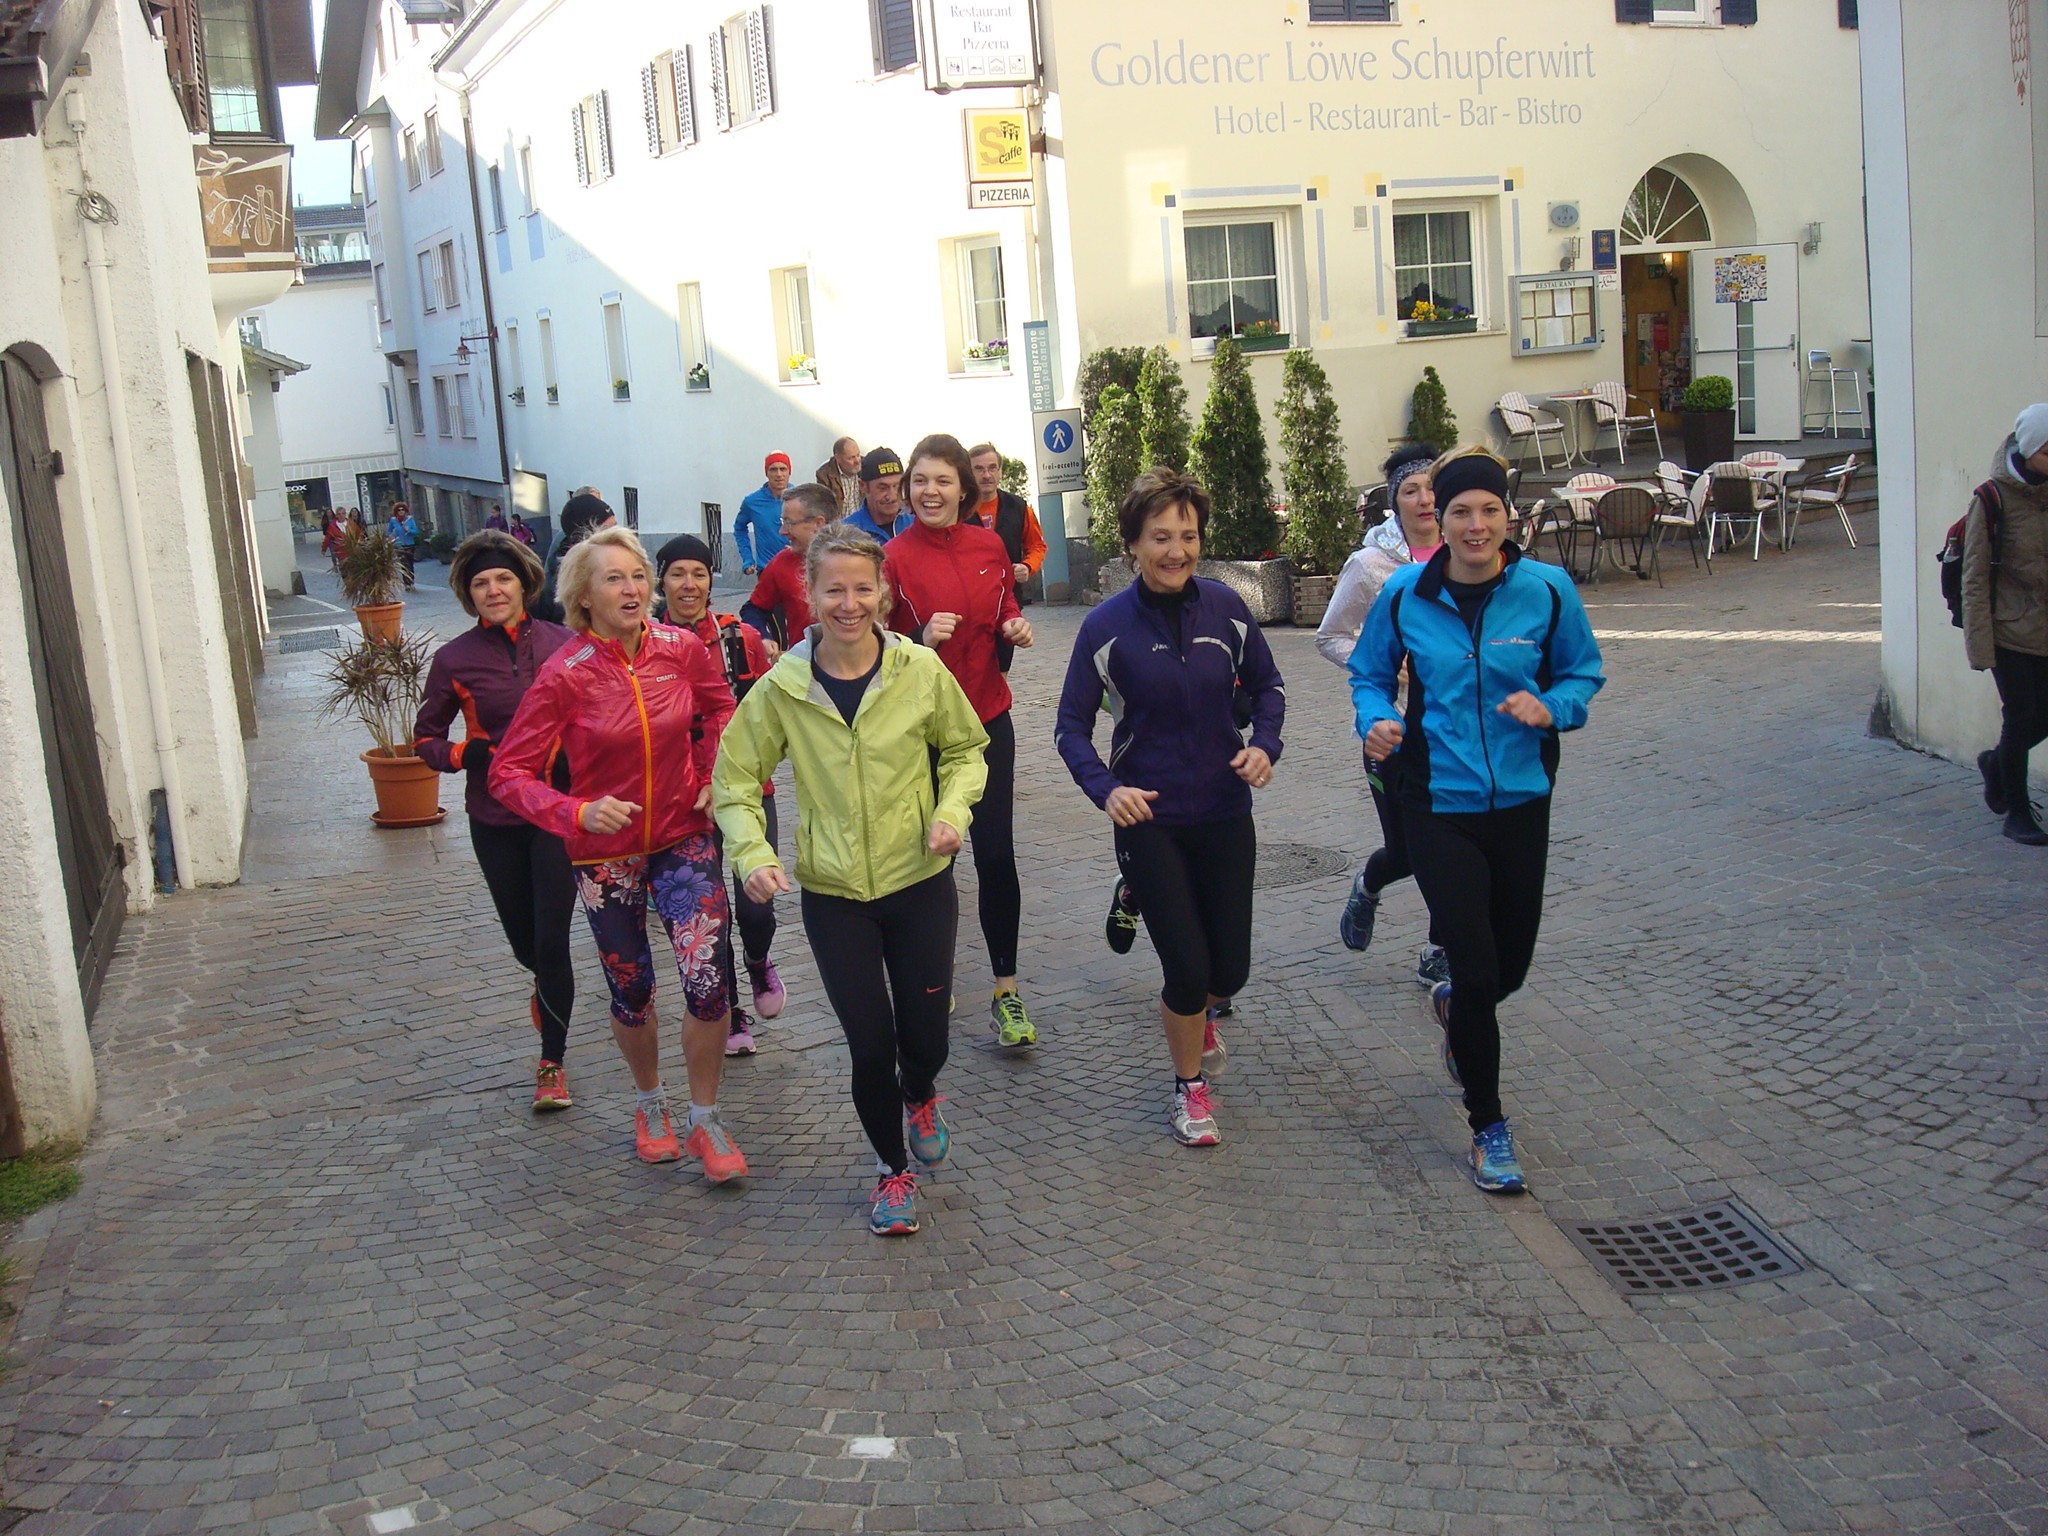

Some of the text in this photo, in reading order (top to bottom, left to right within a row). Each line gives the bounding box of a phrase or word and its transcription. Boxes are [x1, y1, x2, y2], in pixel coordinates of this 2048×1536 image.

[950, 5, 1012, 18] Restaurant
[973, 20, 992, 33] Bar
[963, 37, 1010, 50] Pizzeria
[1091, 36, 1596, 95] Goldener Löwe Schupferwirt
[1214, 101, 1286, 135] Hotel
[1459, 98, 1498, 127] Bar
[1517, 97, 1583, 125] Bistro
[979, 188, 1031, 202] PIZZERIA
[1535, 281, 1576, 289] RESTAURANT
[1038, 328, 1051, 382] pedonale
[1029, 329, 1043, 411] Fußgängerzone
